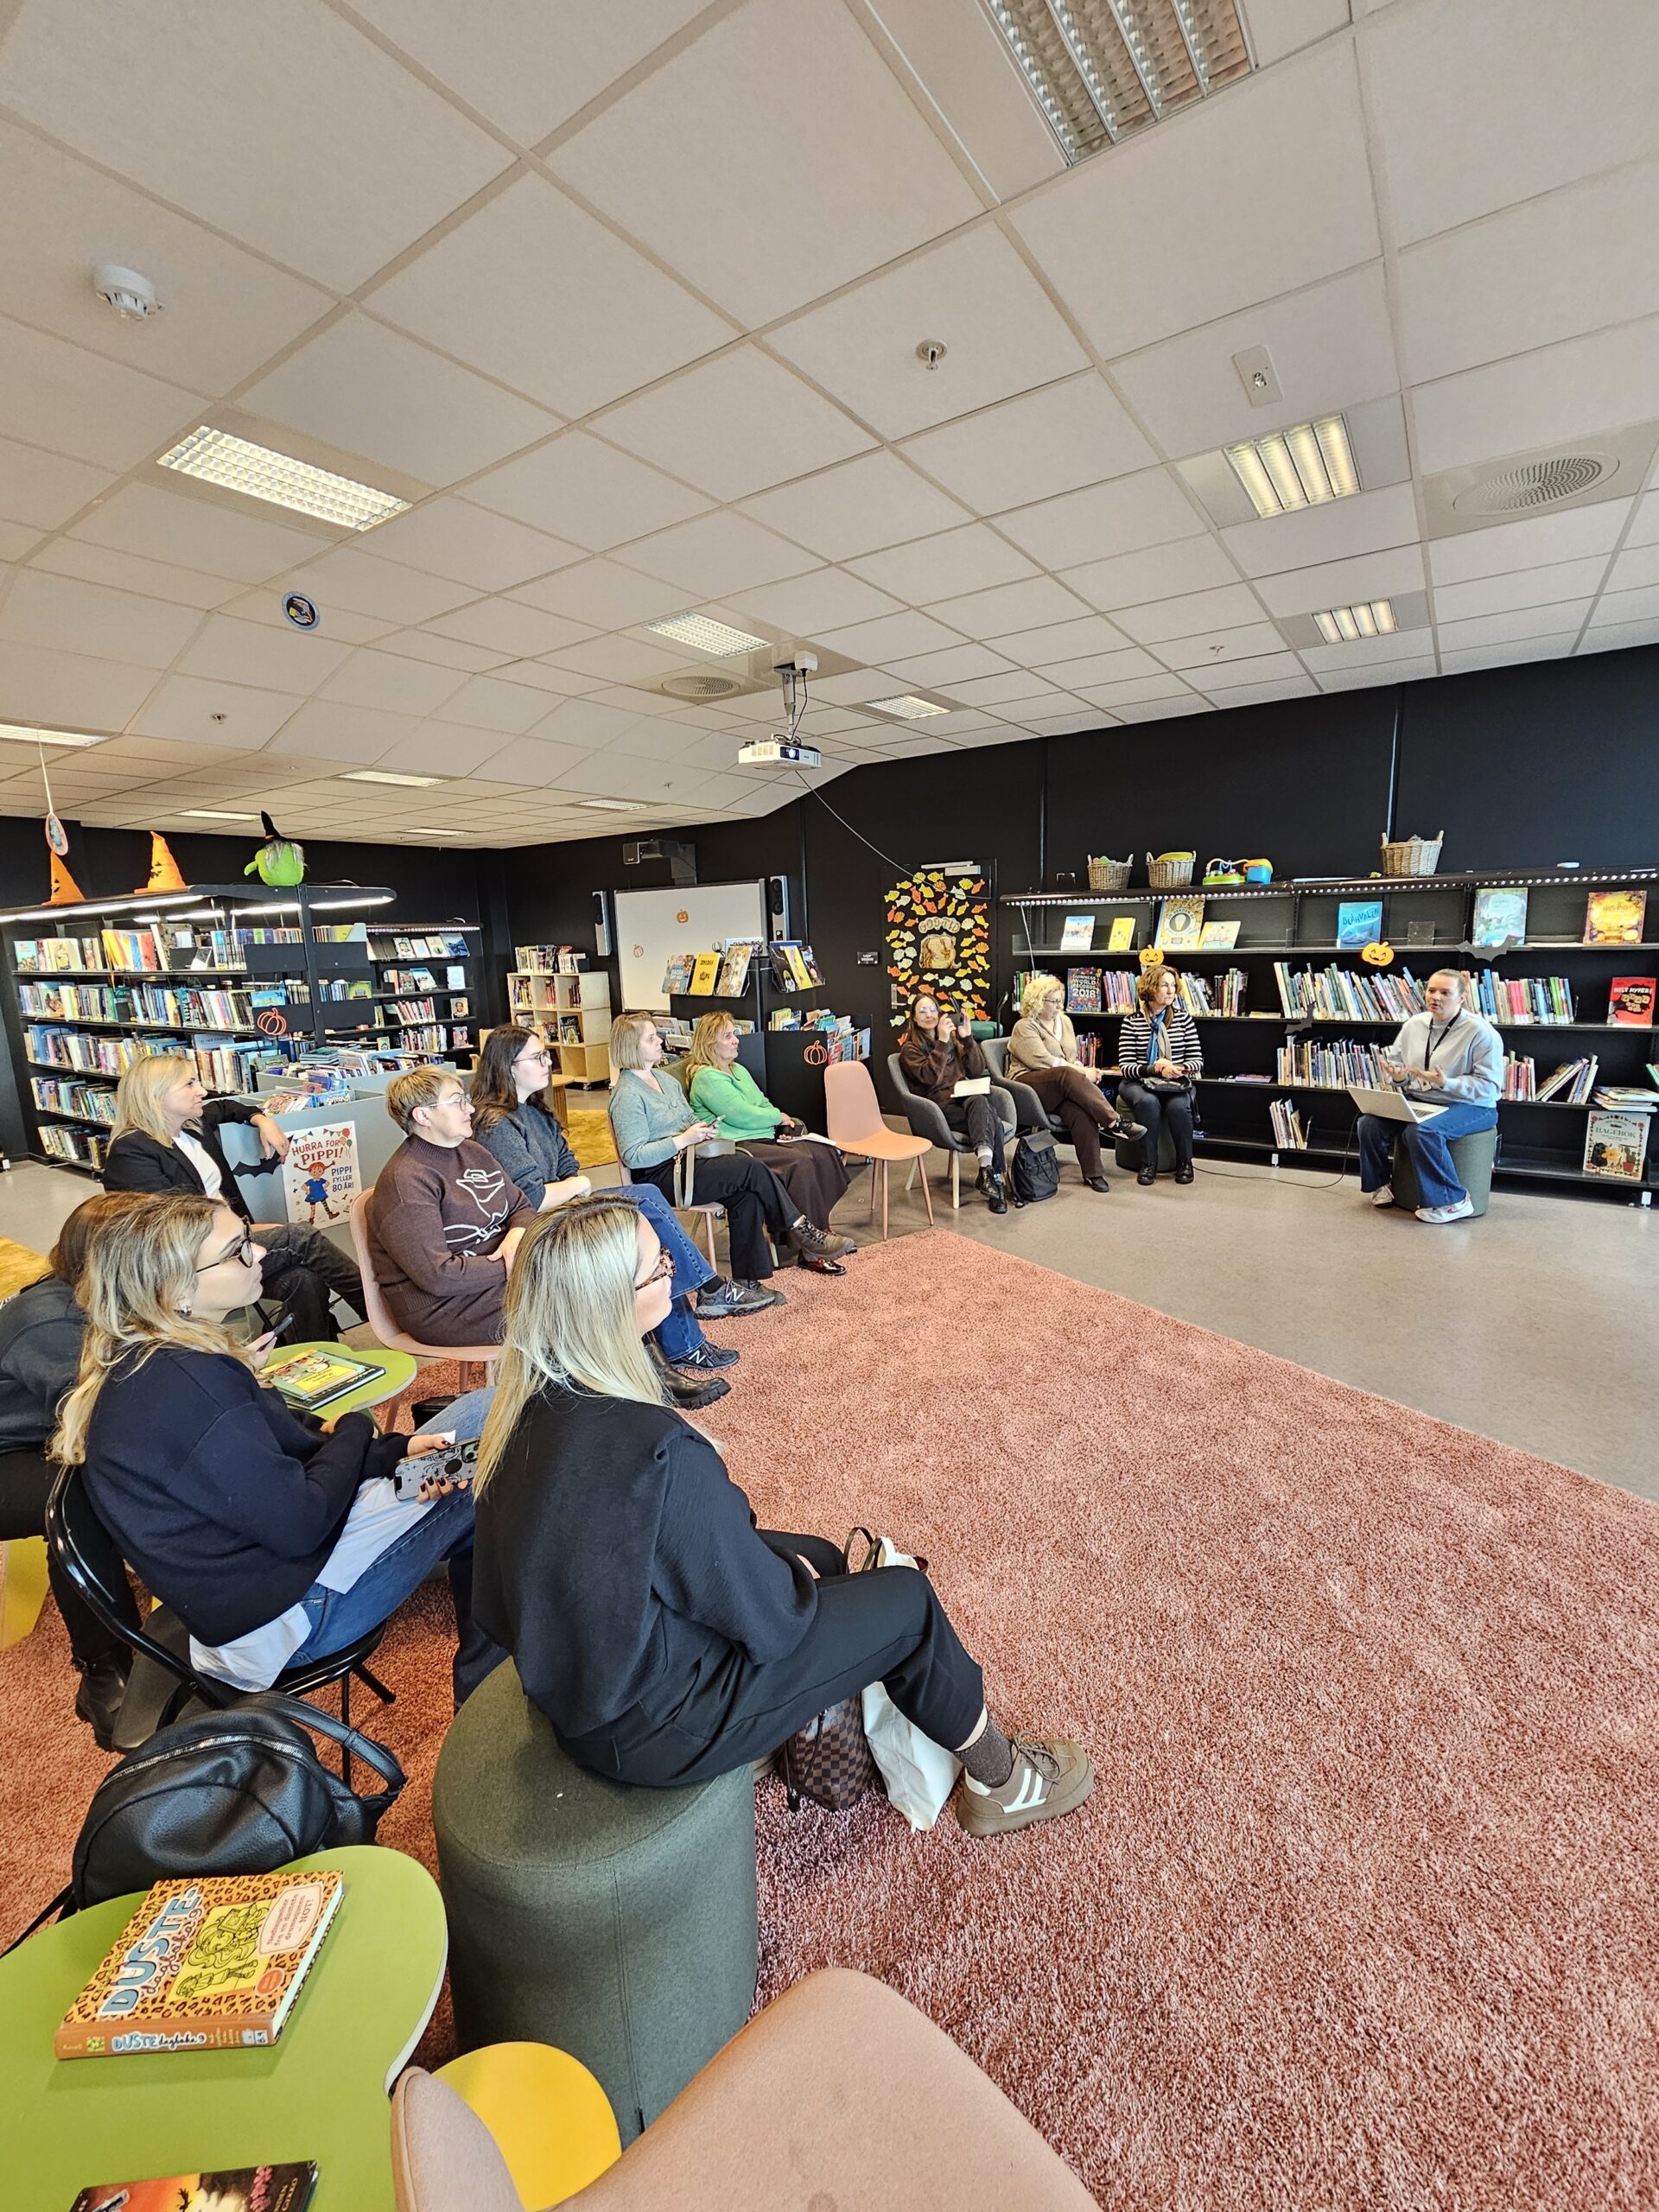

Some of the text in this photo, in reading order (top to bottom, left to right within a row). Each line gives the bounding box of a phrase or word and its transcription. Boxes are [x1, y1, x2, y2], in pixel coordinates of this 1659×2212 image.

[1342, 908, 1379, 925] BLÅHVALEN
[1072, 988, 1096, 999] 2018
[1595, 1127, 1637, 1138] HAGEBOK
[292, 1140, 340, 1156] HURRA FOR
[301, 1147, 344, 1166] PIPPI!
[331, 1166, 353, 1177] PIPPI
[332, 1174, 353, 1184] FYLLER
[332, 1182, 354, 1192] 80 ÅR!
[299, 1898, 315, 1923] NOT!
[141, 1908, 203, 1994] dagboka 9
